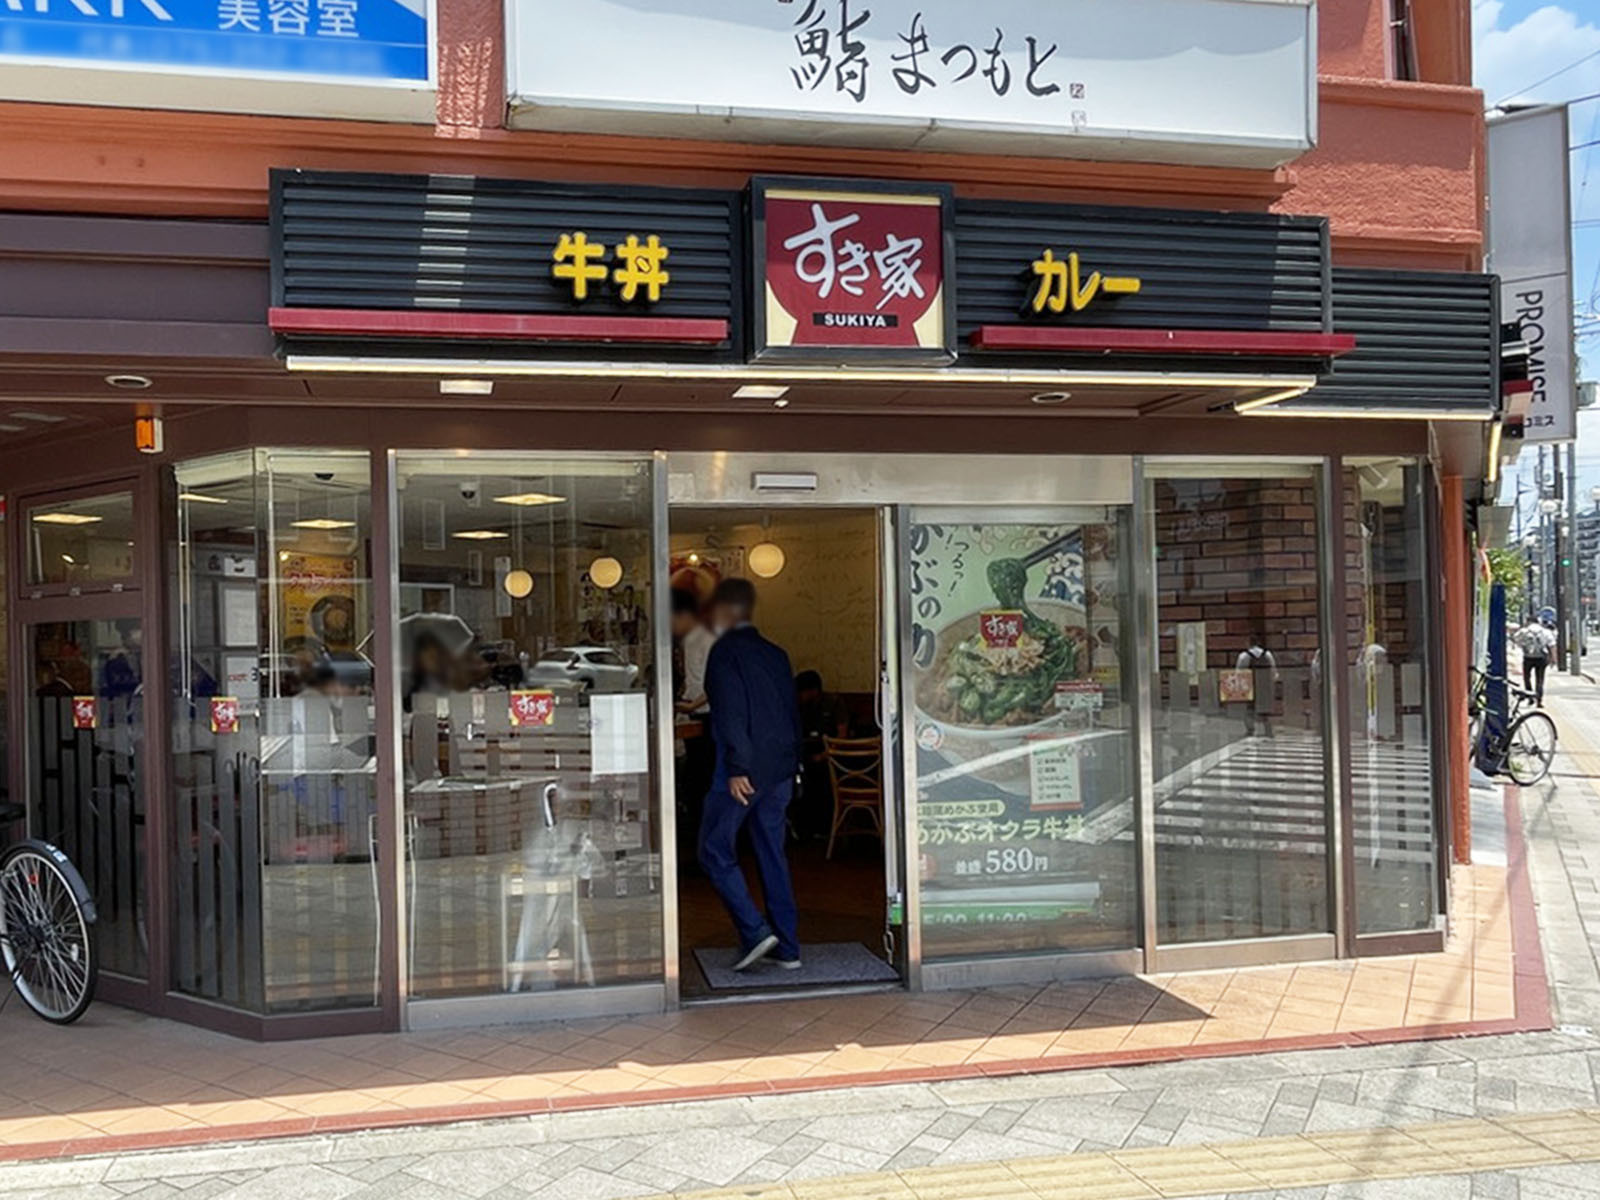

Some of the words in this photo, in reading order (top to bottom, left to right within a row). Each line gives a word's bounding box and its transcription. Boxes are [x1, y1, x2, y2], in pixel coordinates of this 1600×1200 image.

[218, 0, 360, 38] 美容室
[552, 231, 670, 302] 牛丼
[783, 203, 925, 310] すき家
[1031, 248, 1141, 313] カレー
[824, 312, 887, 328] SUKIYA
